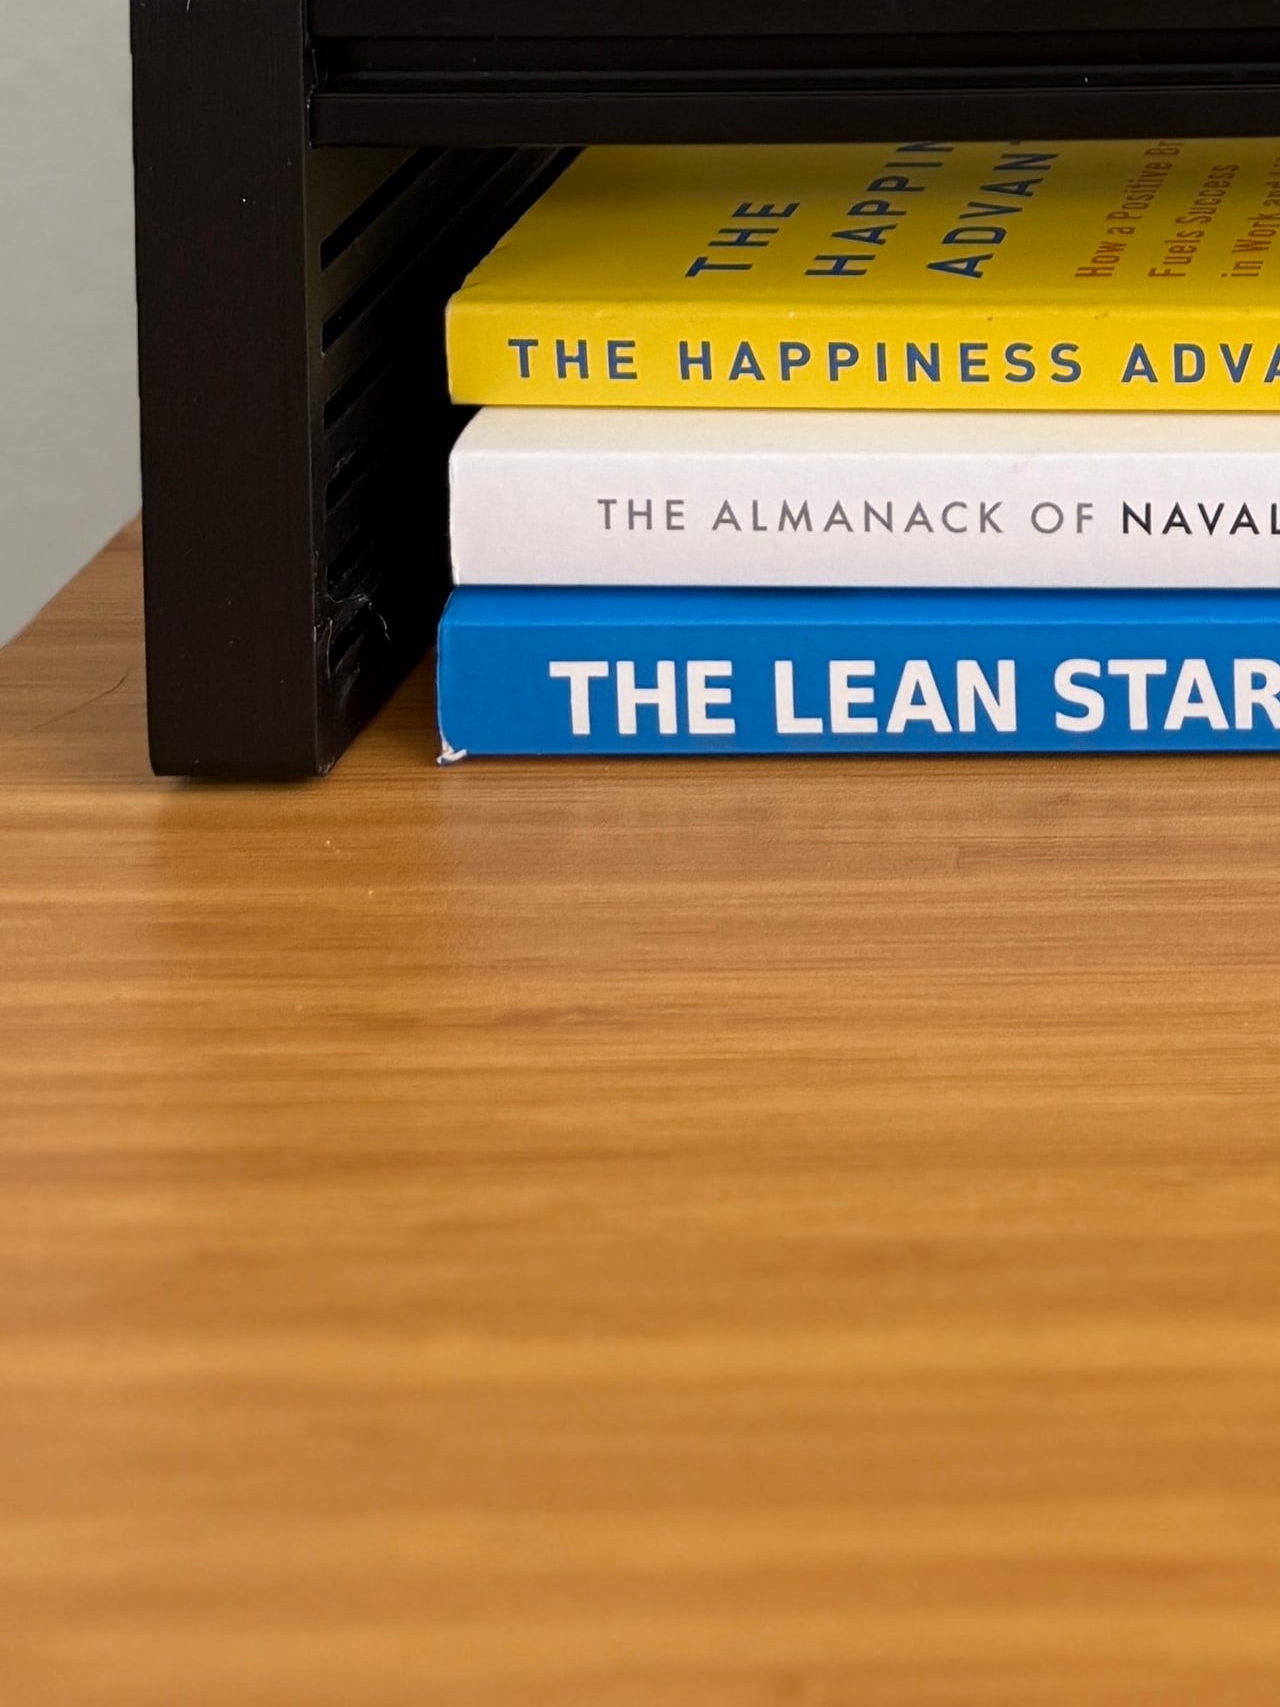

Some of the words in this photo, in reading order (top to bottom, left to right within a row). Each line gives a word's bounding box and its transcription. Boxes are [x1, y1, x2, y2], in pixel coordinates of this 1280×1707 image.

[926, 139, 1059, 278] ADVAN
[1106, 161, 1173, 220] Positive
[1175, 164, 1240, 224] Success
[685, 202, 800, 277] THE
[1106, 226, 1136, 235] a
[1149, 229, 1205, 277] Fuels
[1074, 240, 1128, 277] How
[1221, 260, 1264, 277] in
[508, 339, 637, 379] THE
[680, 341, 1082, 383] HAPPINESS
[598, 498, 685, 531] THE
[712, 499, 1003, 534] ALMANACK
[1030, 501, 1093, 535] OF
[550, 660, 735, 735] THE
[775, 659, 1017, 734] LEAN
